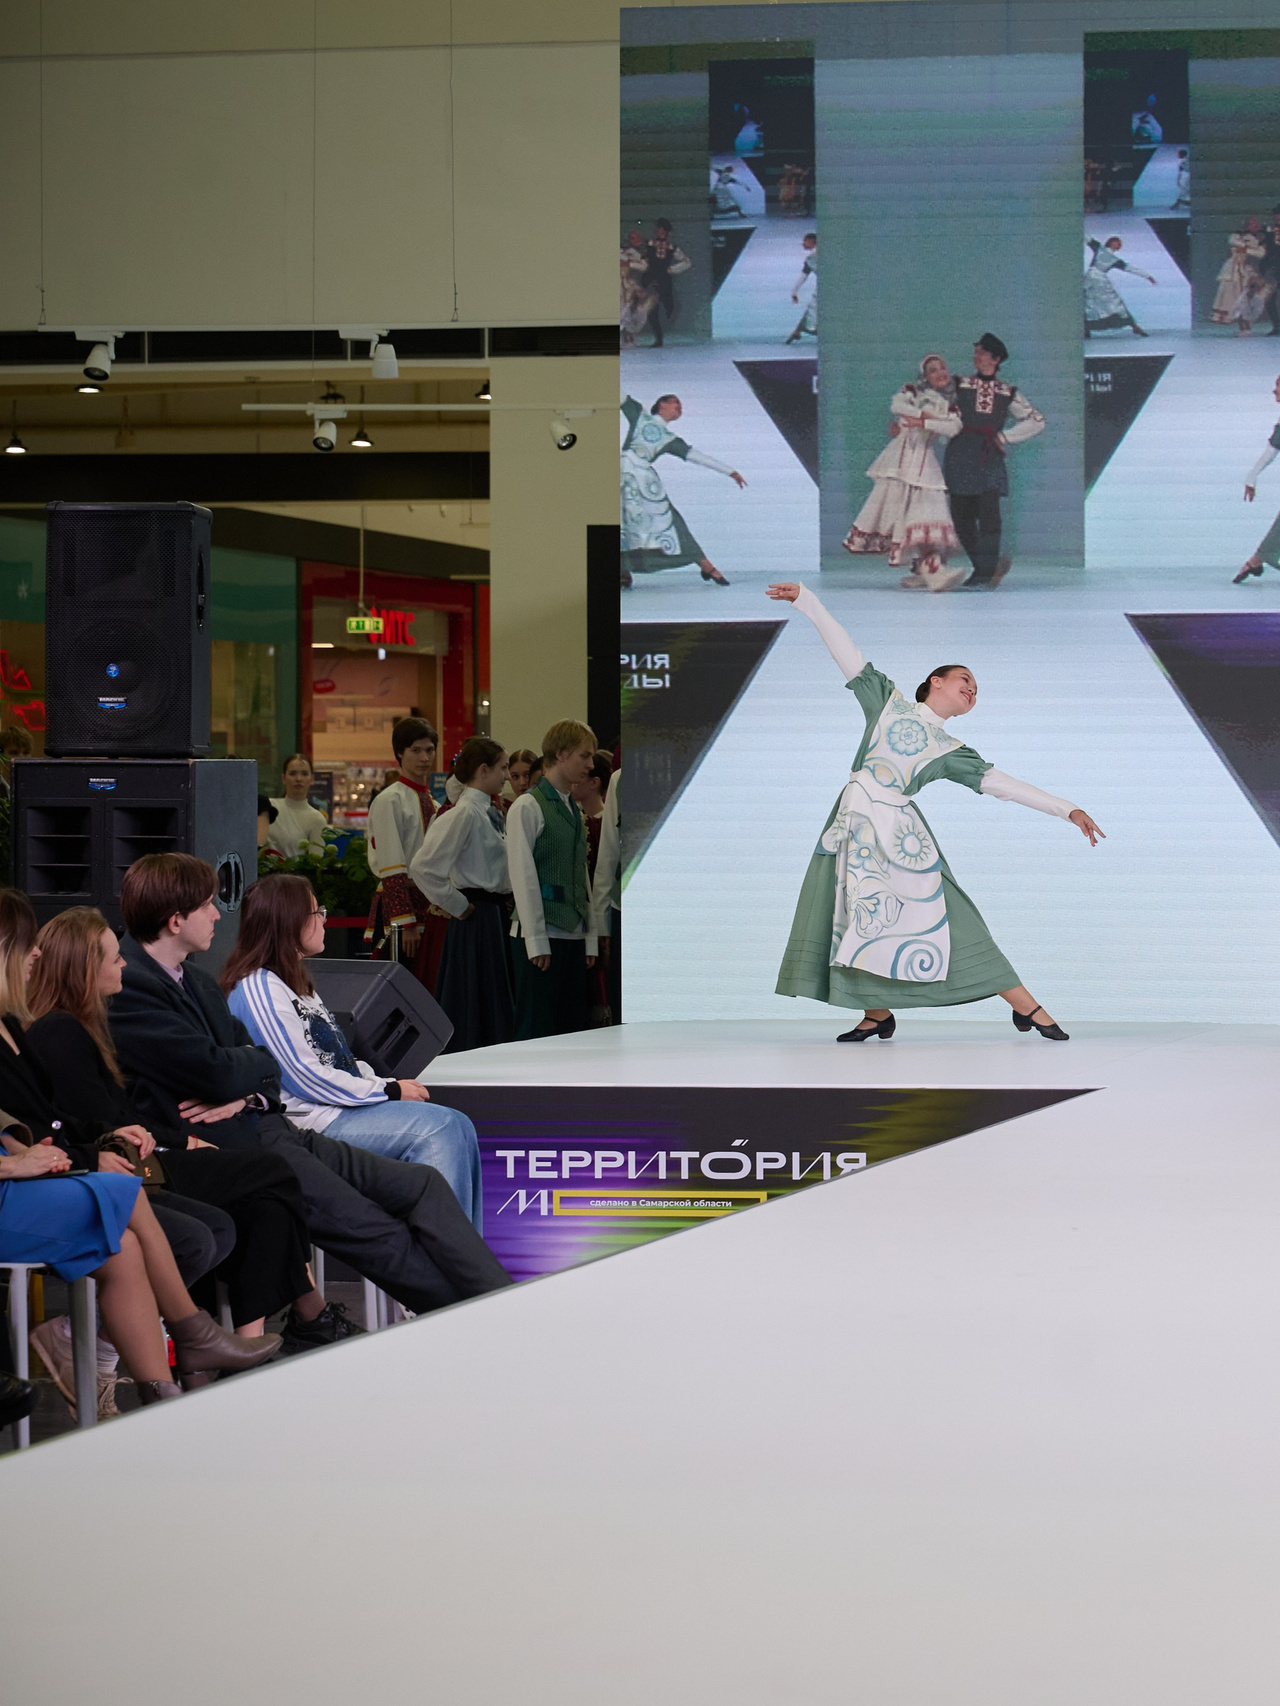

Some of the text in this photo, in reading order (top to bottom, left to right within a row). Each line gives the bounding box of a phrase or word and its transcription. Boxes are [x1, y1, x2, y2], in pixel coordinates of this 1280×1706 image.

[589, 1200, 629, 1208] сделано
[639, 1199, 692, 1210] Самарской
[693, 1199, 732, 1208] области
